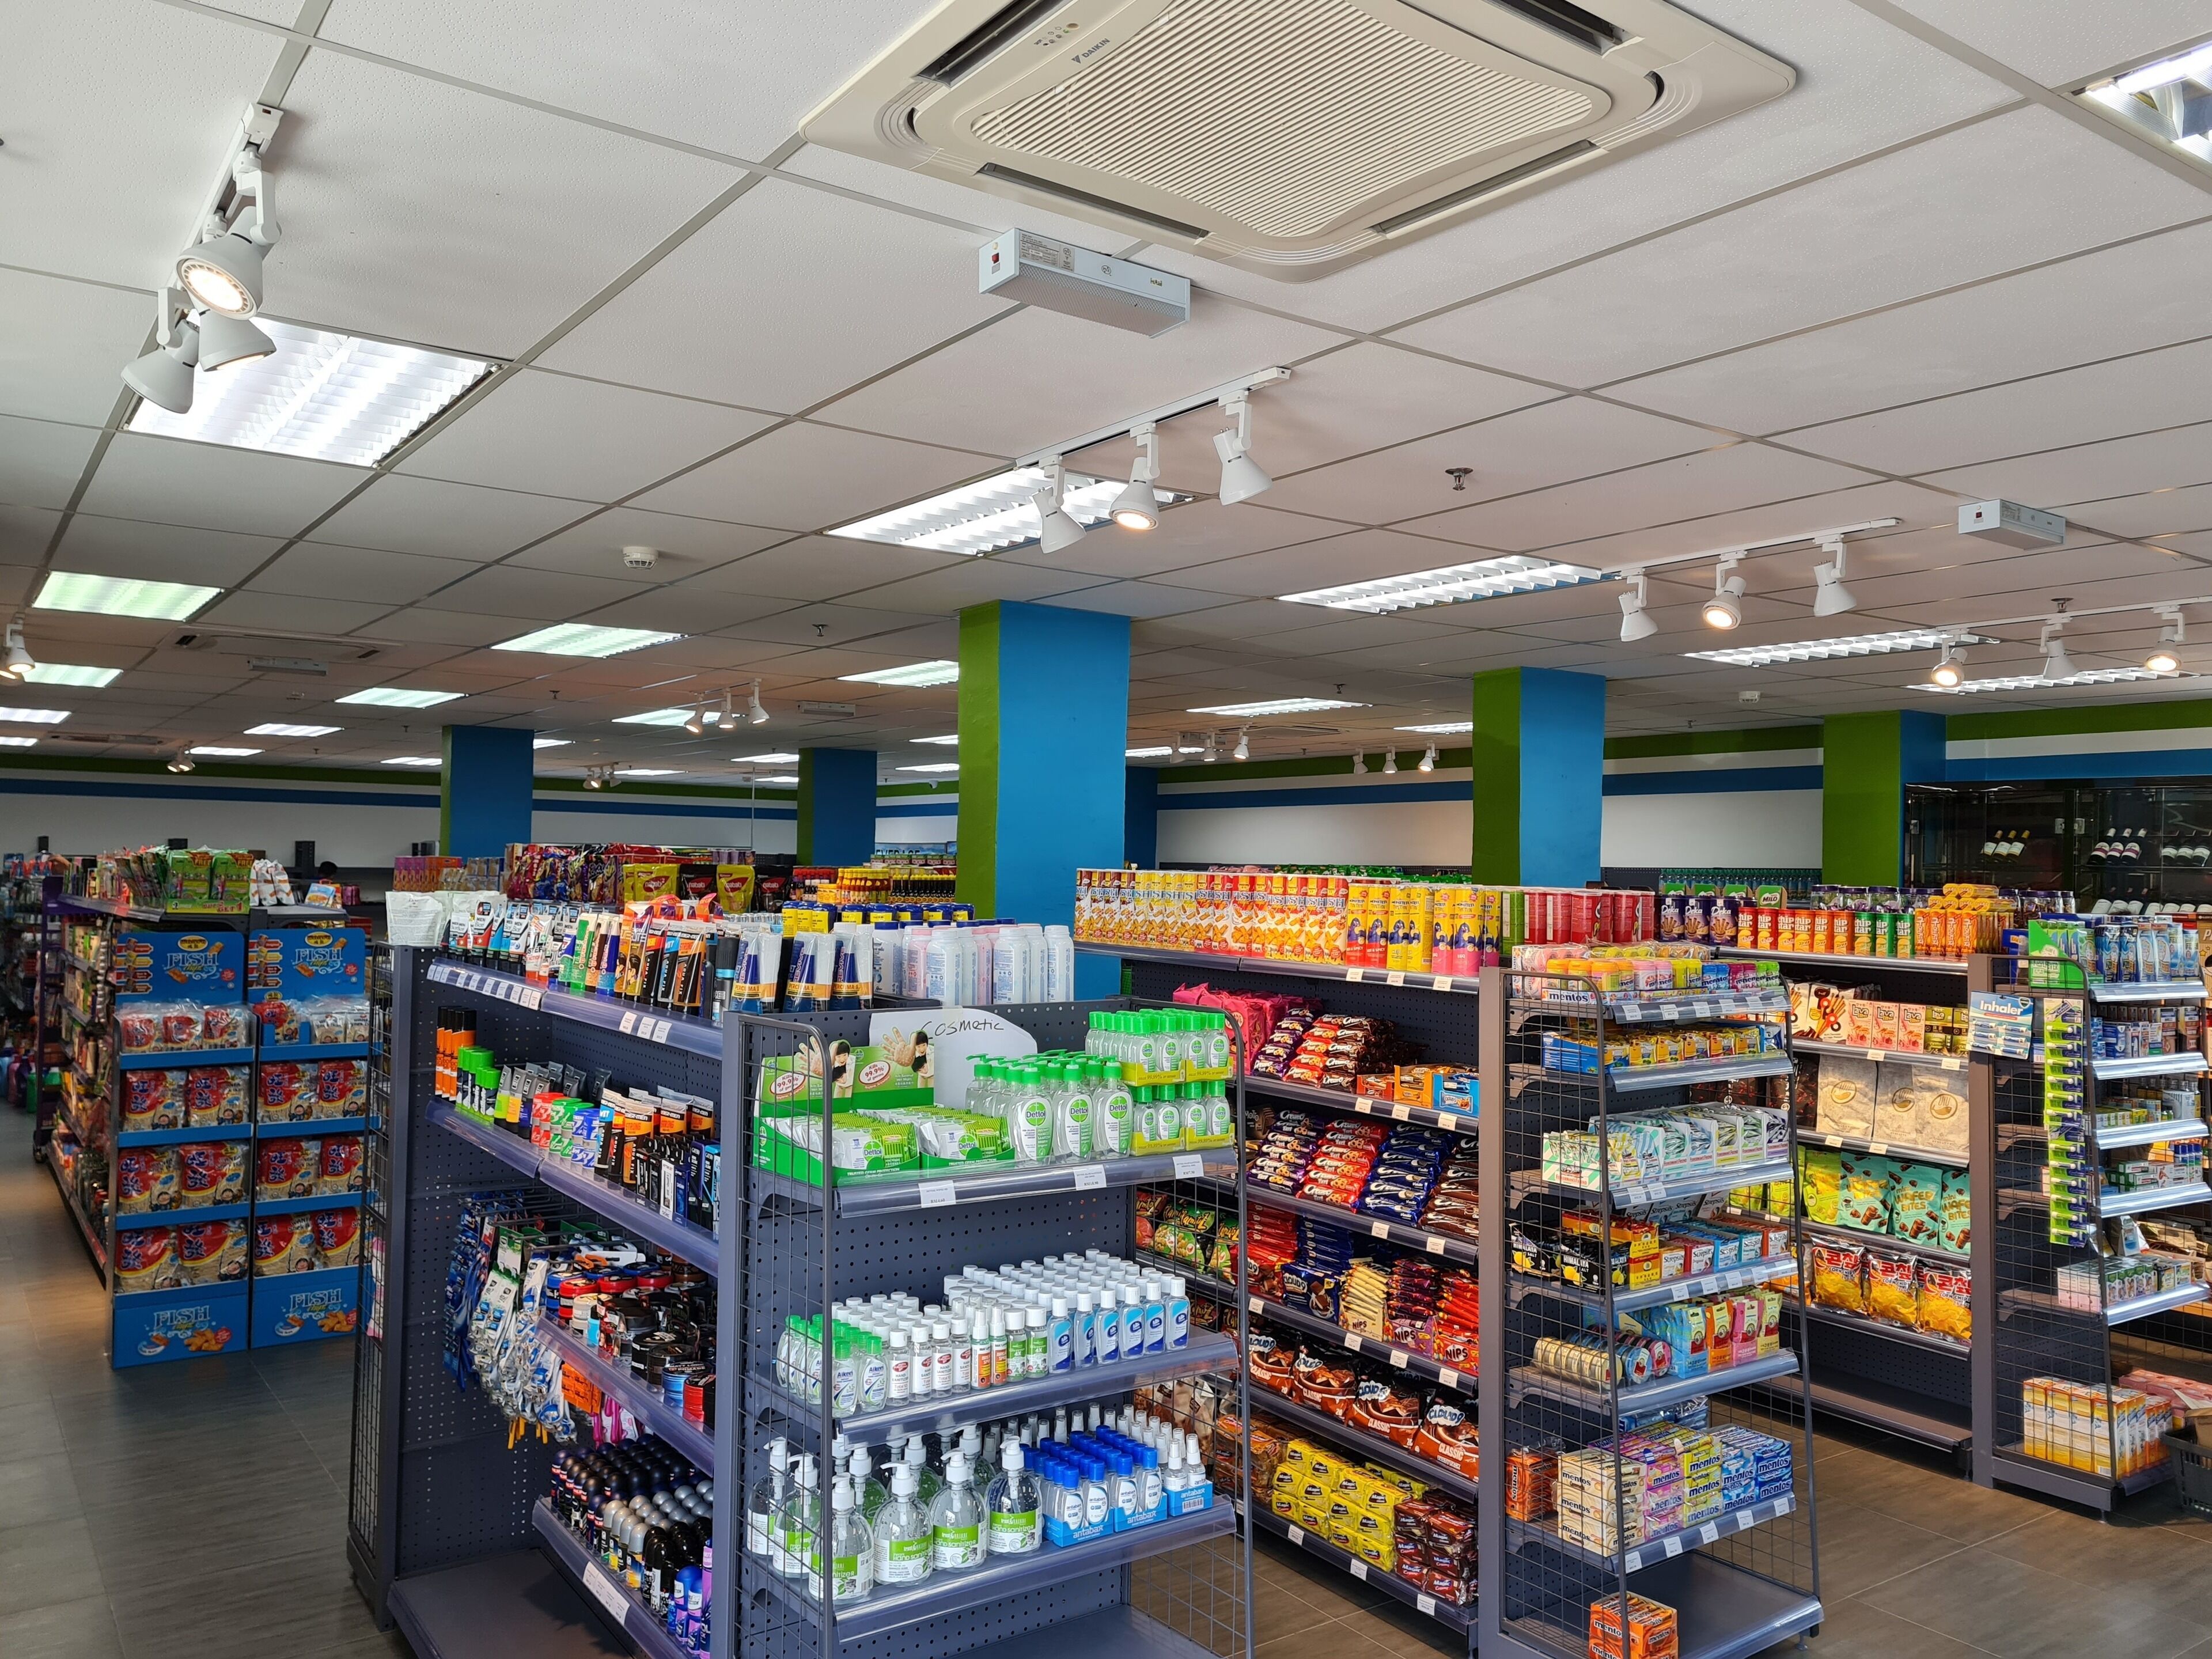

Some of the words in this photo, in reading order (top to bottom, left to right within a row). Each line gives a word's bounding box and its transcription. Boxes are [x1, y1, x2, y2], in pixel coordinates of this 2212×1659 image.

[1081, 38, 1111, 59] DAIKIN
[1661, 905, 1679, 915] Deka
[1685, 906, 1703, 915] Deka
[1711, 906, 1732, 915] Deka
[166, 952, 219, 969] FISH
[296, 948, 343, 964] FISH
[1548, 993, 1589, 1003] mentos
[1852, 1004, 1869, 1016] Lava
[1877, 1006, 1895, 1018] Lava
[1904, 1009, 1922, 1021] Lava
[1979, 999, 2023, 1016] Inhaler
[921, 1021, 1005, 1040] Cosmetic
[1026, 1110, 1046, 1118] Dettol
[863, 1147, 882, 1156] Dettol
[958, 1142, 976, 1150] Dettol
[1896, 1190, 1936, 1202] WAFER
[1901, 1202, 1926, 1211] BITES
[1941, 1199, 1971, 1213] WAFE
[1513, 1243, 1537, 1253] HIMALAYA
[1563, 1255, 1589, 1268] HIMALAYA
[290, 1288, 342, 1310] FISH
[153, 1305, 210, 1329] FISH
[1352, 1319, 1367, 1330] NIPS
[1394, 1329, 1416, 1341] NIPS
[1445, 1347, 1468, 1361] NIPS
[1302, 1387, 1322, 1402] CLASSIC
[1368, 1417, 1390, 1434] CLASSIC
[1438, 1443, 1465, 1461] CLASSIC
[1689, 1454, 1721, 1472] mentos
[1759, 1456, 1789, 1473] mentos
[1562, 1471, 1591, 1486] mentos
[1653, 1470, 1680, 1486] mentos
[1723, 1469, 1754, 1484] mentos
[1181, 1488, 1205, 1498] antabax
[1689, 1479, 1720, 1497] mentos
[1760, 1480, 1791, 1498] mentos
[1562, 1498, 1590, 1514] mentos
[1724, 1493, 1755, 1510] mentos
[1127, 1511, 1157, 1524] antabax
[1073, 1525, 1104, 1539] antabax
[1562, 1525, 1591, 1541] mentos
[1594, 1620, 1622, 1638] mento
[1649, 1629, 1670, 1645] mentos
